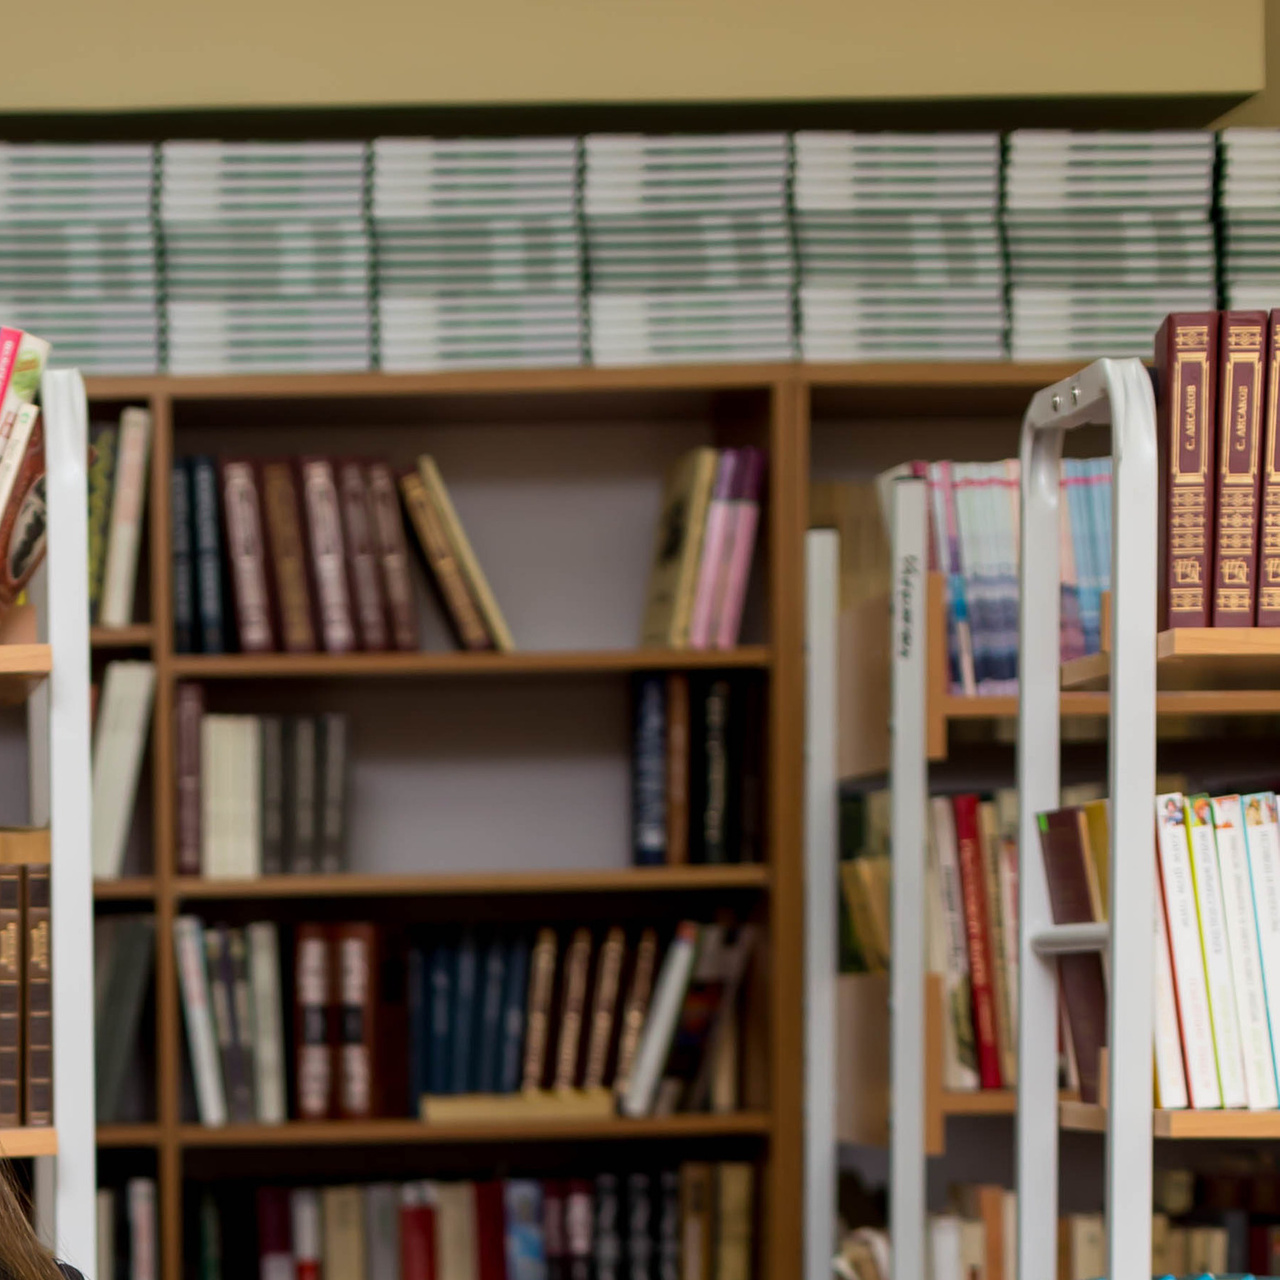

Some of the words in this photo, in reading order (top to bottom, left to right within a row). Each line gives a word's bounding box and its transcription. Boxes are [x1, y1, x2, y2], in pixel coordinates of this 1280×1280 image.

[1185, 384, 1197, 437] АКСАКОВ
[1235, 385, 1248, 437] АКСАКОВ
[1185, 438, 1196, 451] С.
[1235, 438, 1246, 452] С.
